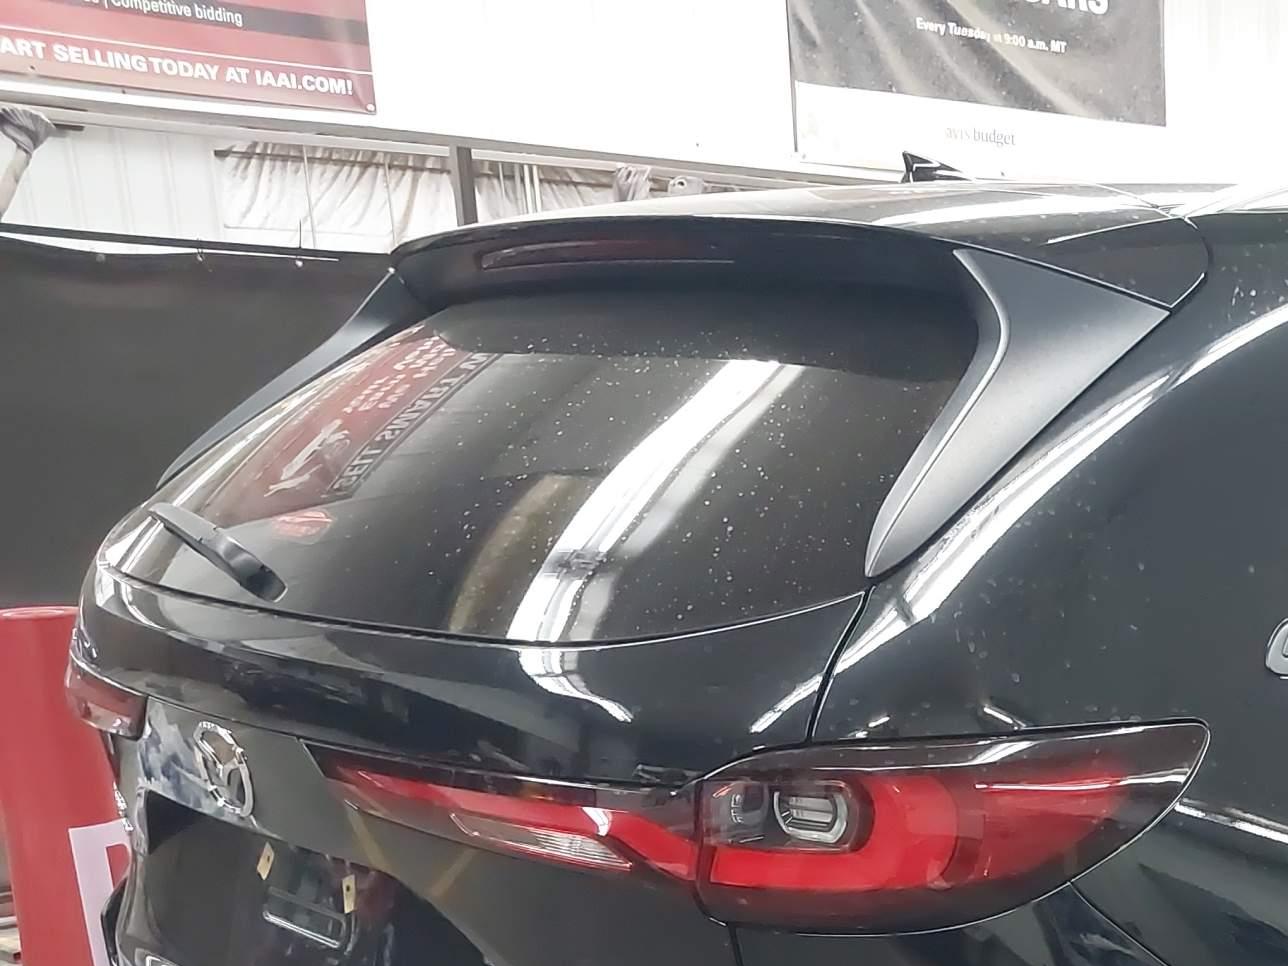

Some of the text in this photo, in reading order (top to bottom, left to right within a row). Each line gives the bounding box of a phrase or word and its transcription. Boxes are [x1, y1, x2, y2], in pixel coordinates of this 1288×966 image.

[195, 2, 243, 26] bidding
[915, 17, 946, 37] Every
[948, 22, 991, 43] Tuesday
[1004, 32, 1026, 48] 9:00
[1027, 38, 1049, 51] a.m.
[1050, 39, 1068, 54] MT
[54, 43, 147, 73] SELLING
[147, 56, 219, 82] TODAY
[224, 67, 250, 85] AT
[255, 69, 354, 96] IAAI.COM!
[973, 127, 1017, 148] budget
